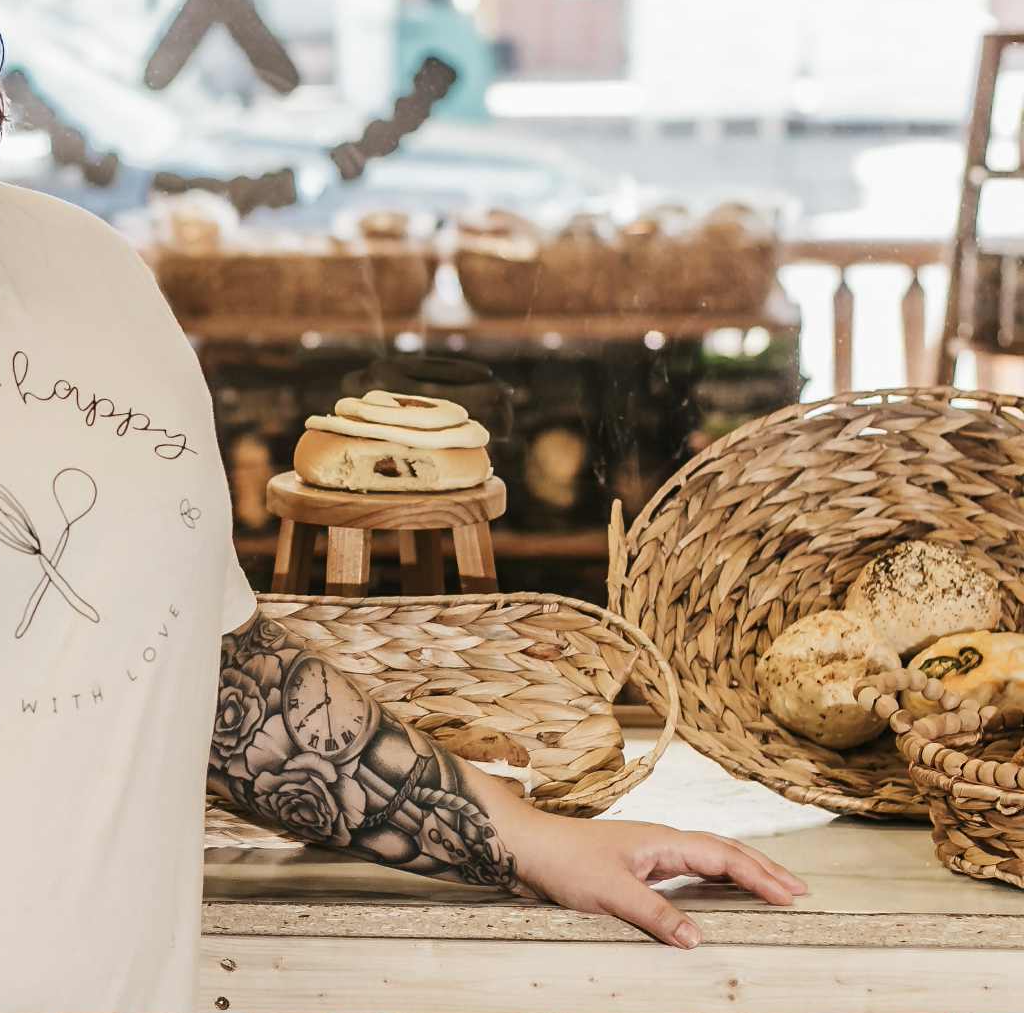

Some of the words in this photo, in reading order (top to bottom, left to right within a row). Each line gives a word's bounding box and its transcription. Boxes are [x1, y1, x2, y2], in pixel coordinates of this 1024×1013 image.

[12, 350, 199, 460] happy
[20, 688, 104, 715] WITH
[127, 603, 180, 682] LOVE
